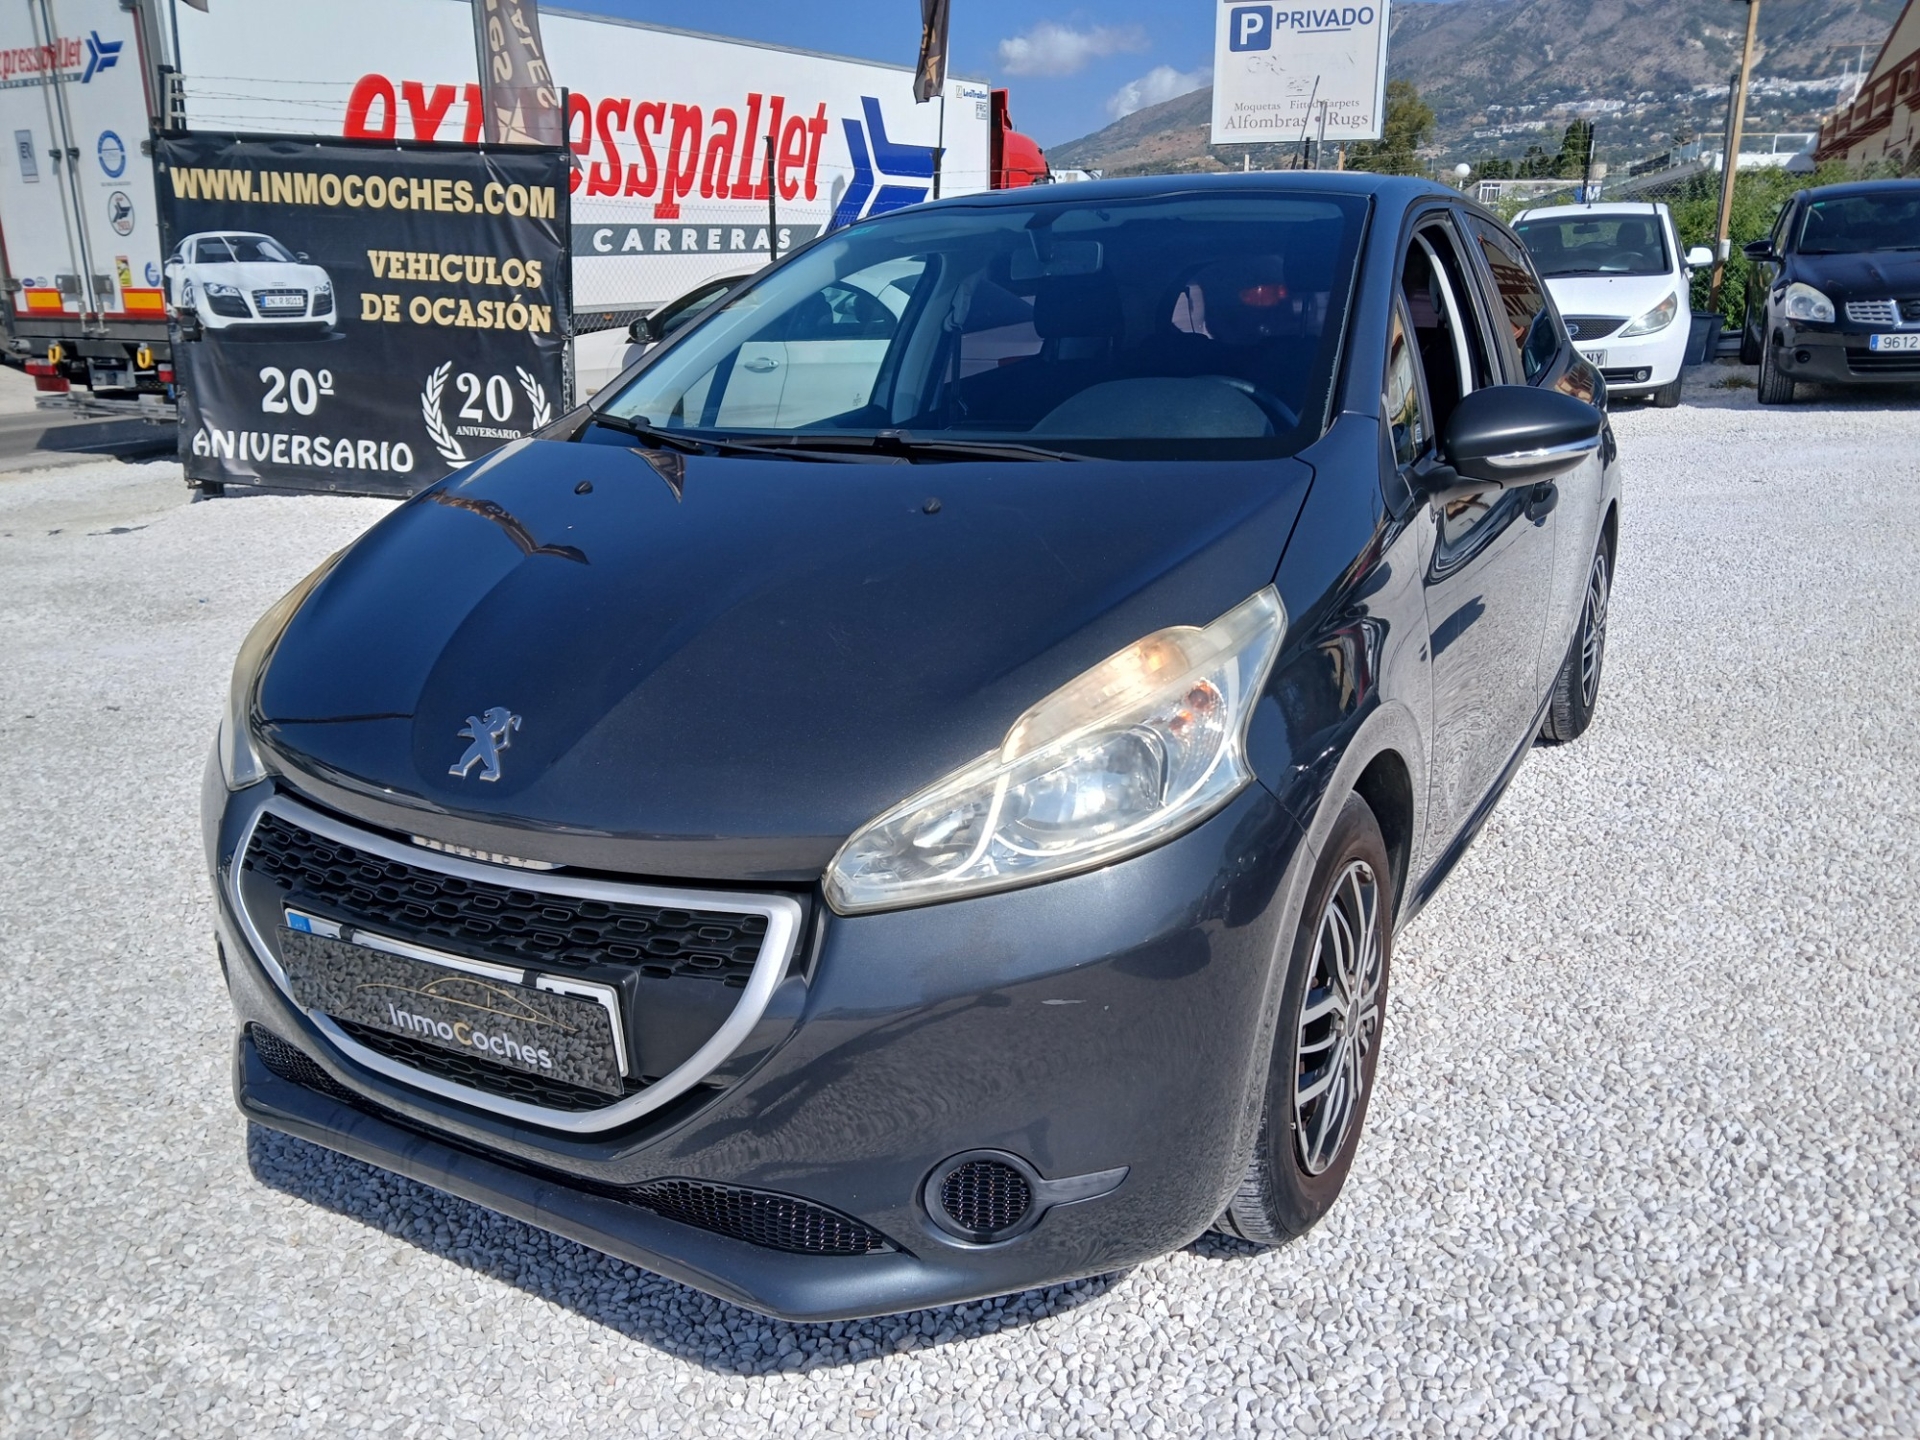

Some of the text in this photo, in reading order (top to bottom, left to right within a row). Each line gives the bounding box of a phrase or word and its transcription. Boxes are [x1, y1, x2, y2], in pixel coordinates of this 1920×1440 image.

[1240, 7, 1374, 45] P PRIVADO
[1225, 111, 1369, 130] Alfombras Rugs
[1234, 102, 1281, 113] Moquetas
[1290, 99, 1320, 110] Fitted
[170, 167, 556, 219] WWW.INMOCOCHES.COM
[593, 228, 791, 253] CARRERAS
[367, 250, 542, 289] VEHICULOS
[360, 293, 552, 333] DE OCASIÓN
[1883, 336, 1919, 349] 9612
[456, 372, 513, 423] 20
[192, 427, 414, 473] ANIVERSARIO
[455, 425, 521, 440] ANIVERSARIO
[388, 1003, 552, 1068] InmoCoches
